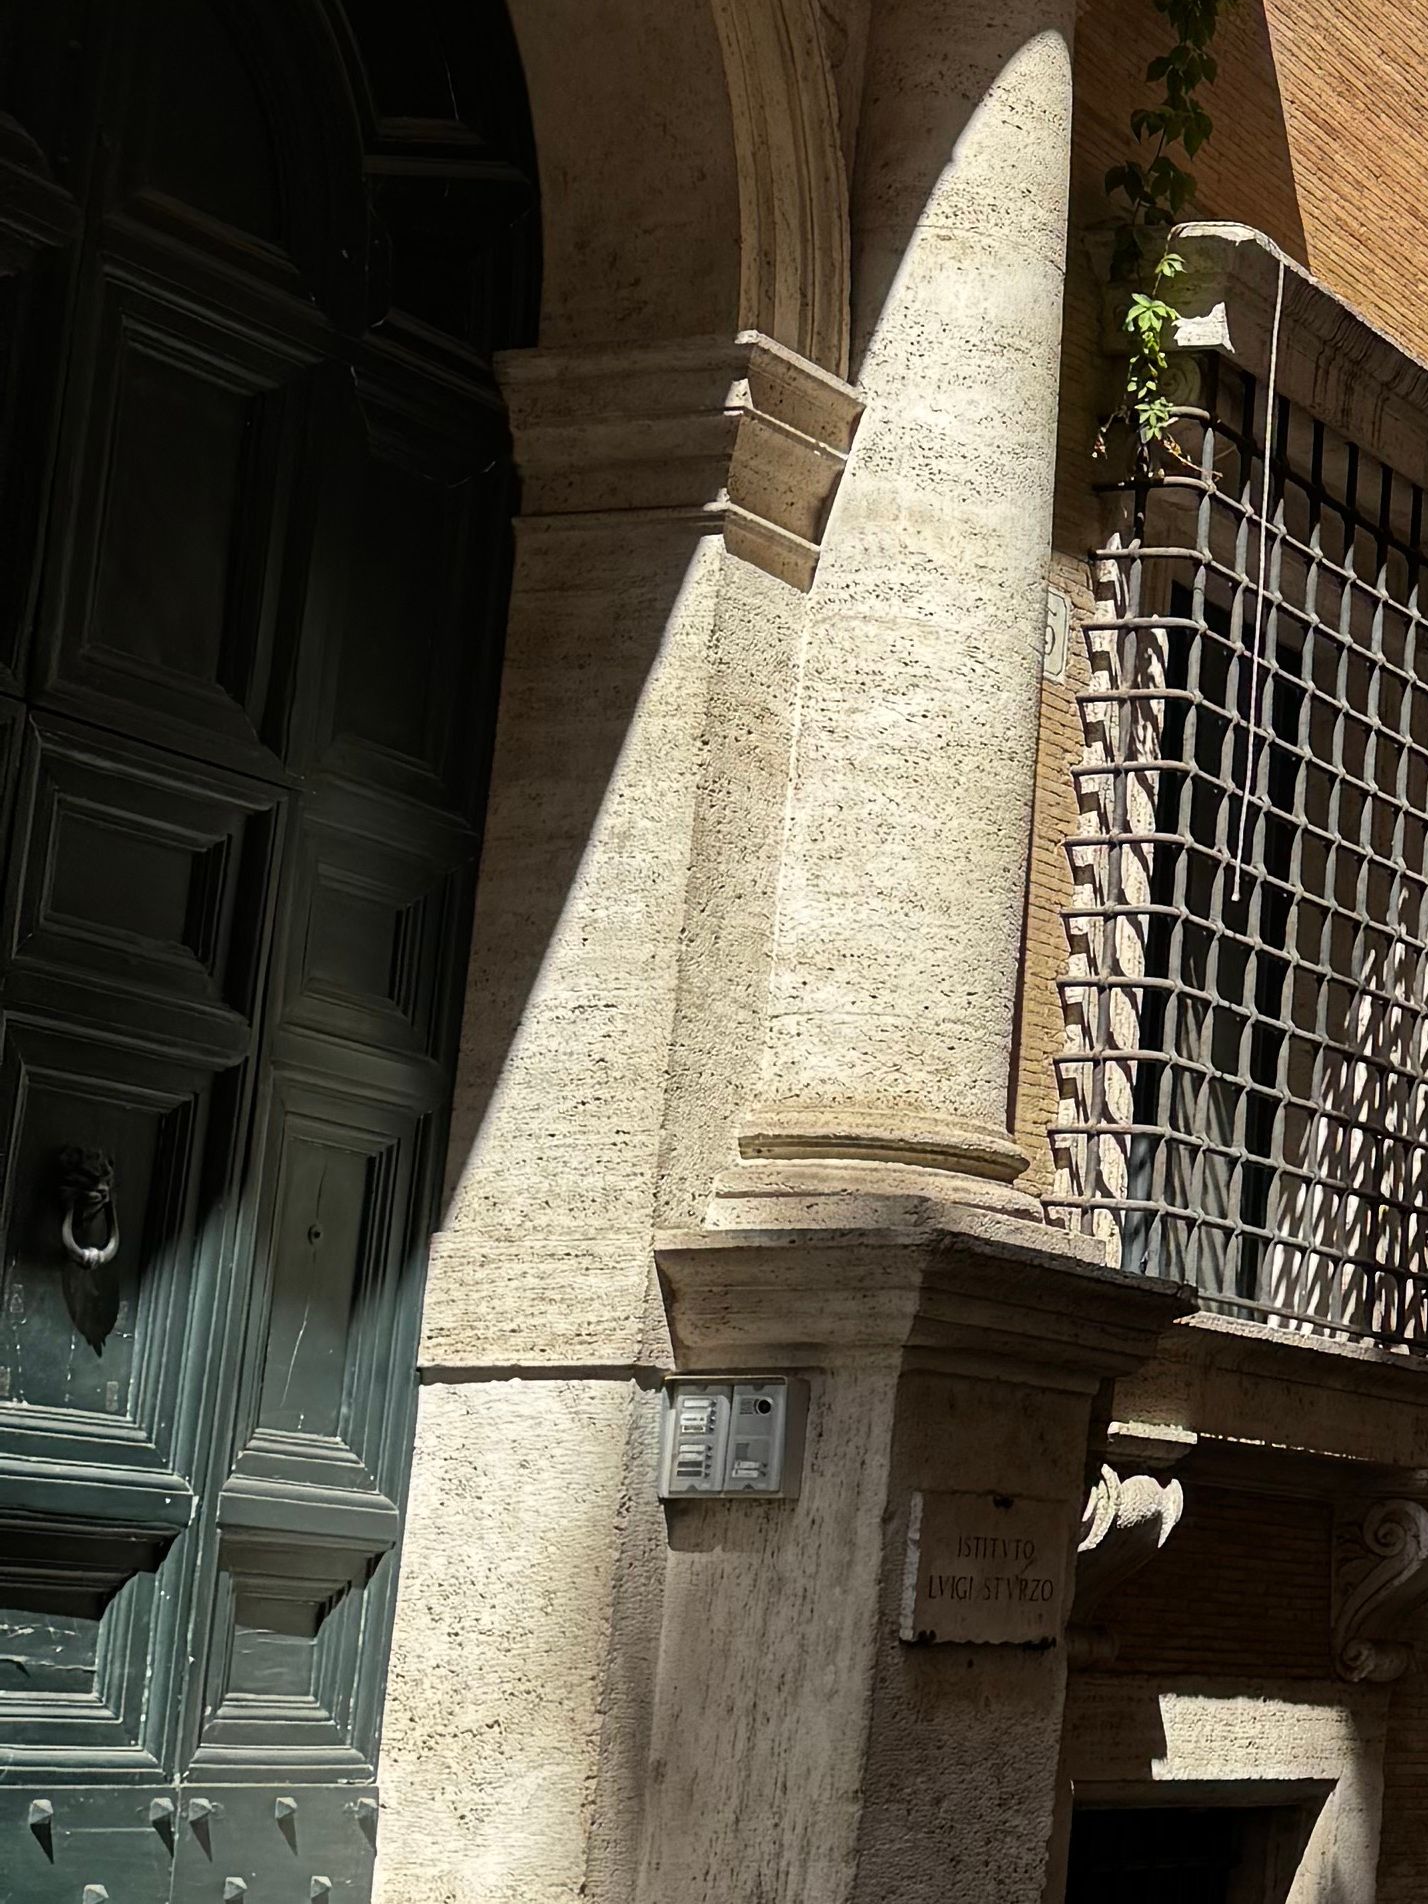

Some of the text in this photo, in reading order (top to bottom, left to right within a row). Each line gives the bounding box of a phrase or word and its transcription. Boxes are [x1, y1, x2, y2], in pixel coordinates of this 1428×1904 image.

[958, 1535, 1035, 1560] ISTITVTO
[928, 1575, 1054, 1602] LVIGI STVRZO
